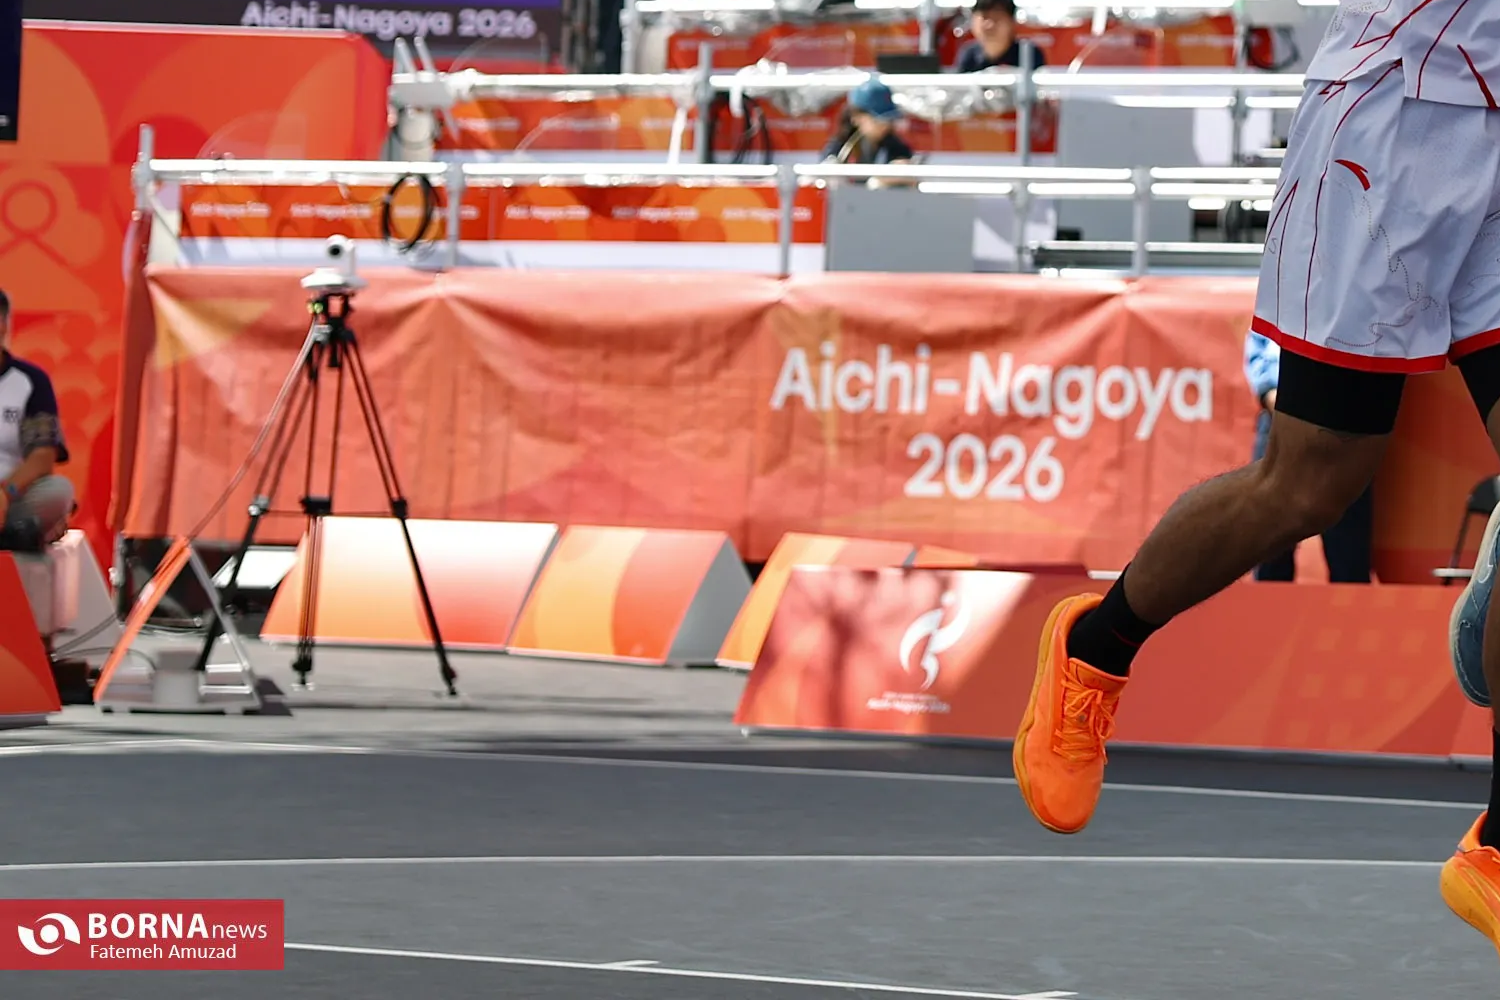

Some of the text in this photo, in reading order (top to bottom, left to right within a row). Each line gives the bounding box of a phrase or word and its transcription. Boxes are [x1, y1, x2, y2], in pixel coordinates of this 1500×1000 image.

[240, 0, 537, 39] Aichi-Nagoya 2026
[770, 341, 1213, 441] Aichi-Nagoya
[903, 433, 1066, 502] 2026
